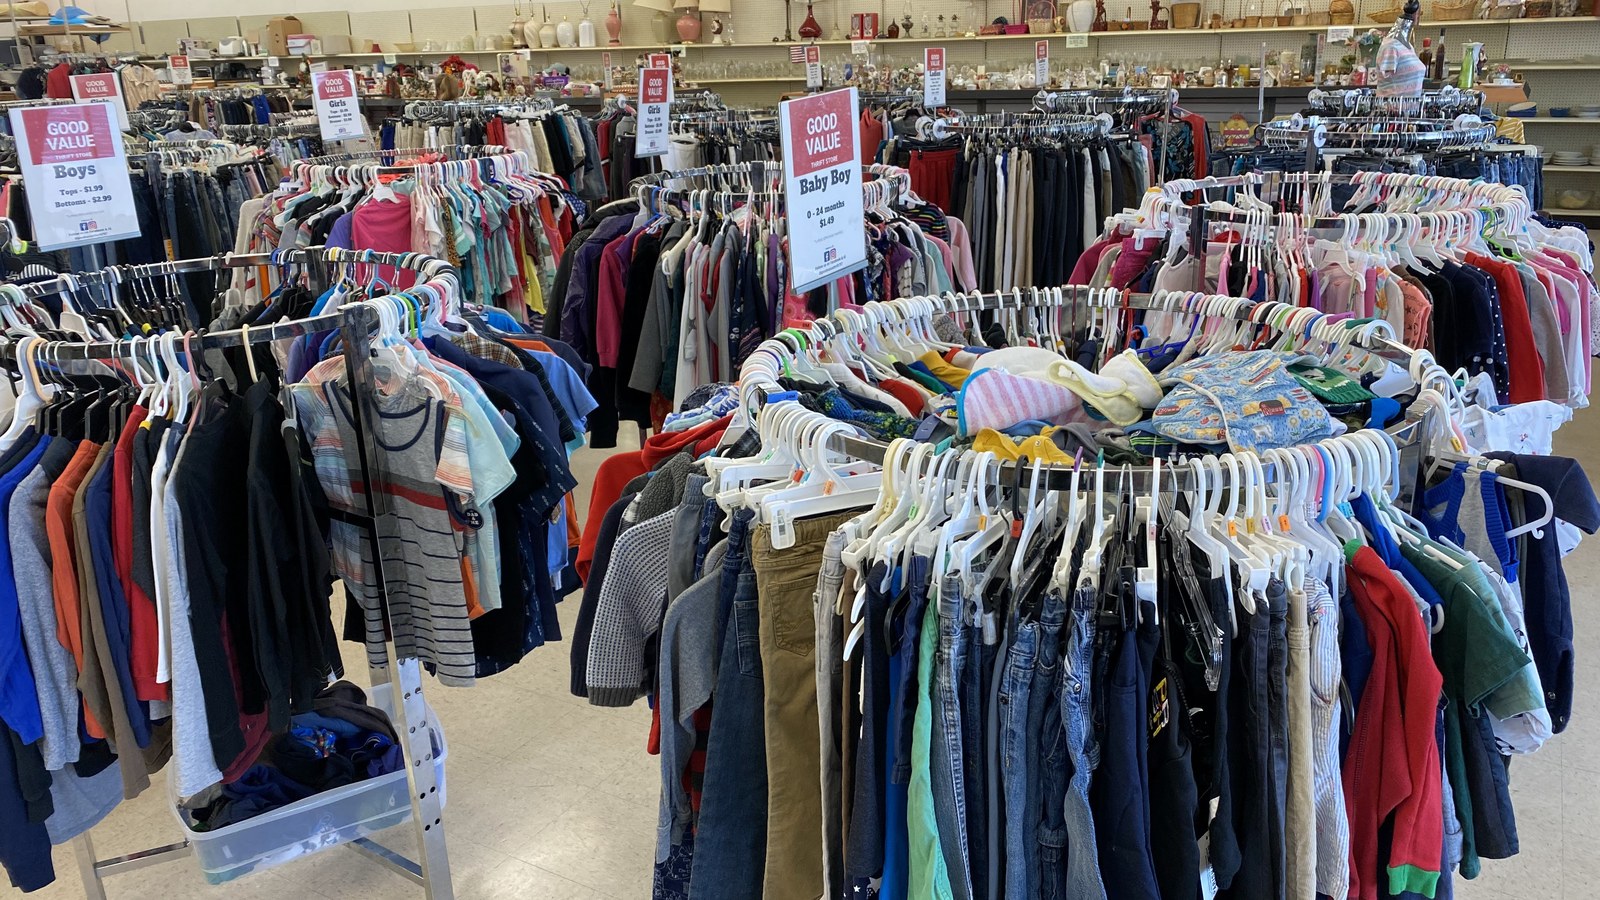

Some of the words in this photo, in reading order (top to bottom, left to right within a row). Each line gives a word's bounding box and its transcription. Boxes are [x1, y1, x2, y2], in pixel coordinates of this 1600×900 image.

[325, 78, 342, 86] GOOD
[649, 78, 662, 86] GOOD
[648, 88, 663, 96] VALUE
[648, 106, 660, 114] Girls
[47, 120, 89, 135] GOOD
[807, 113, 837, 135] GOOD
[46, 134, 96, 150] VALUE
[805, 131, 841, 155] VALUE
[811, 160, 825, 168] THRIFT
[826, 155, 838, 164] STORE
[53, 164, 96, 179] Boys
[800, 174, 828, 195] Baby
[831, 169, 851, 185] Boy
[55, 199, 86, 208] Bottoms
[92, 195, 112, 203] $2.99
[807, 210, 811, 219] 0
[816, 206, 823, 216] 24
[825, 200, 845, 213] months
[820, 216, 835, 228] $1.49
